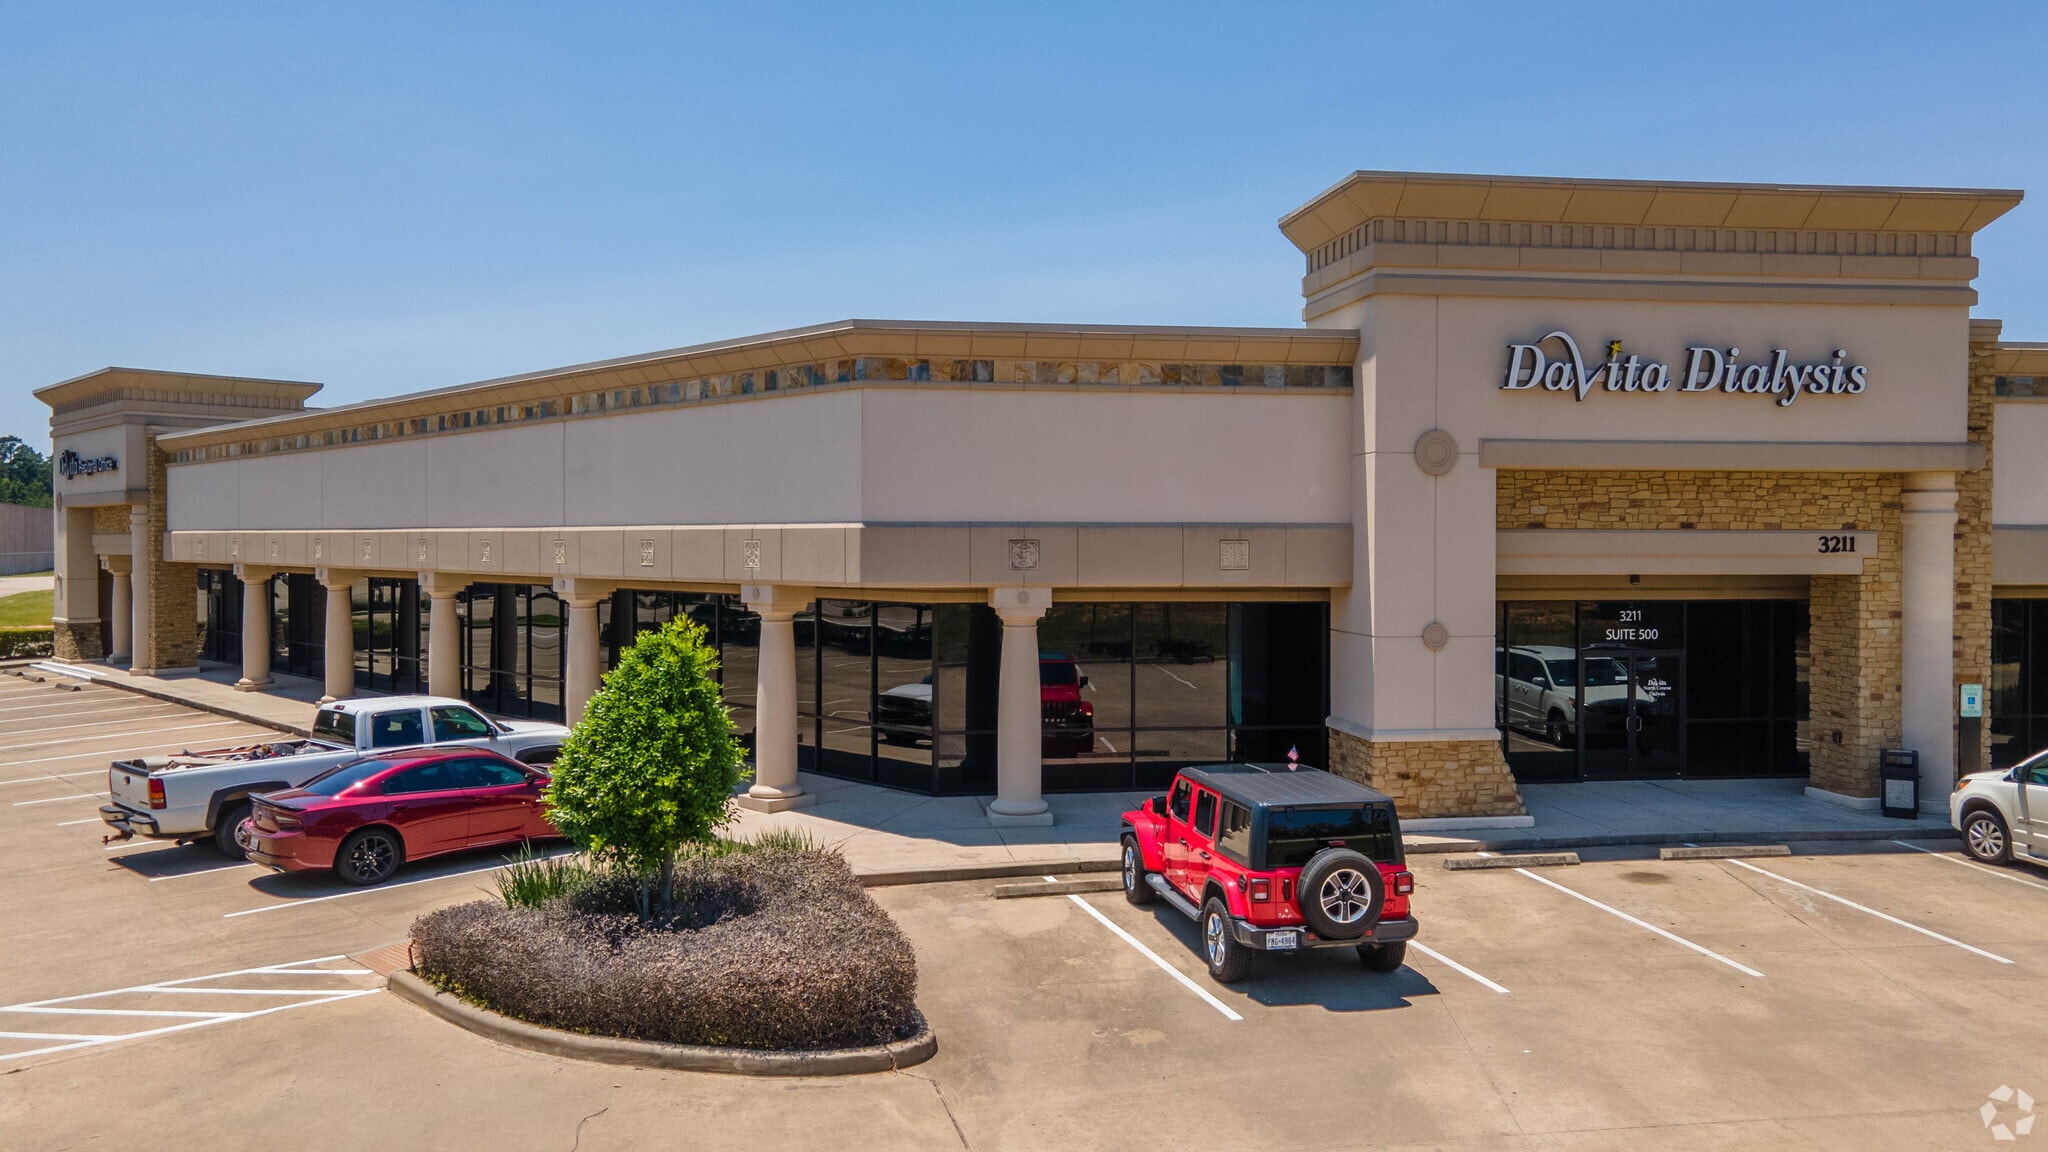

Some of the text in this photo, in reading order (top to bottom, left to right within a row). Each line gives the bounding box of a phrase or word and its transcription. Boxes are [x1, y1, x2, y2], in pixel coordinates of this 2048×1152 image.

[1501, 331, 1868, 406] DaVita Dialysis
[1818, 535, 1856, 553] 3211
[1619, 610, 1642, 621] 3211
[1605, 629, 1659, 640] SUITE 500
